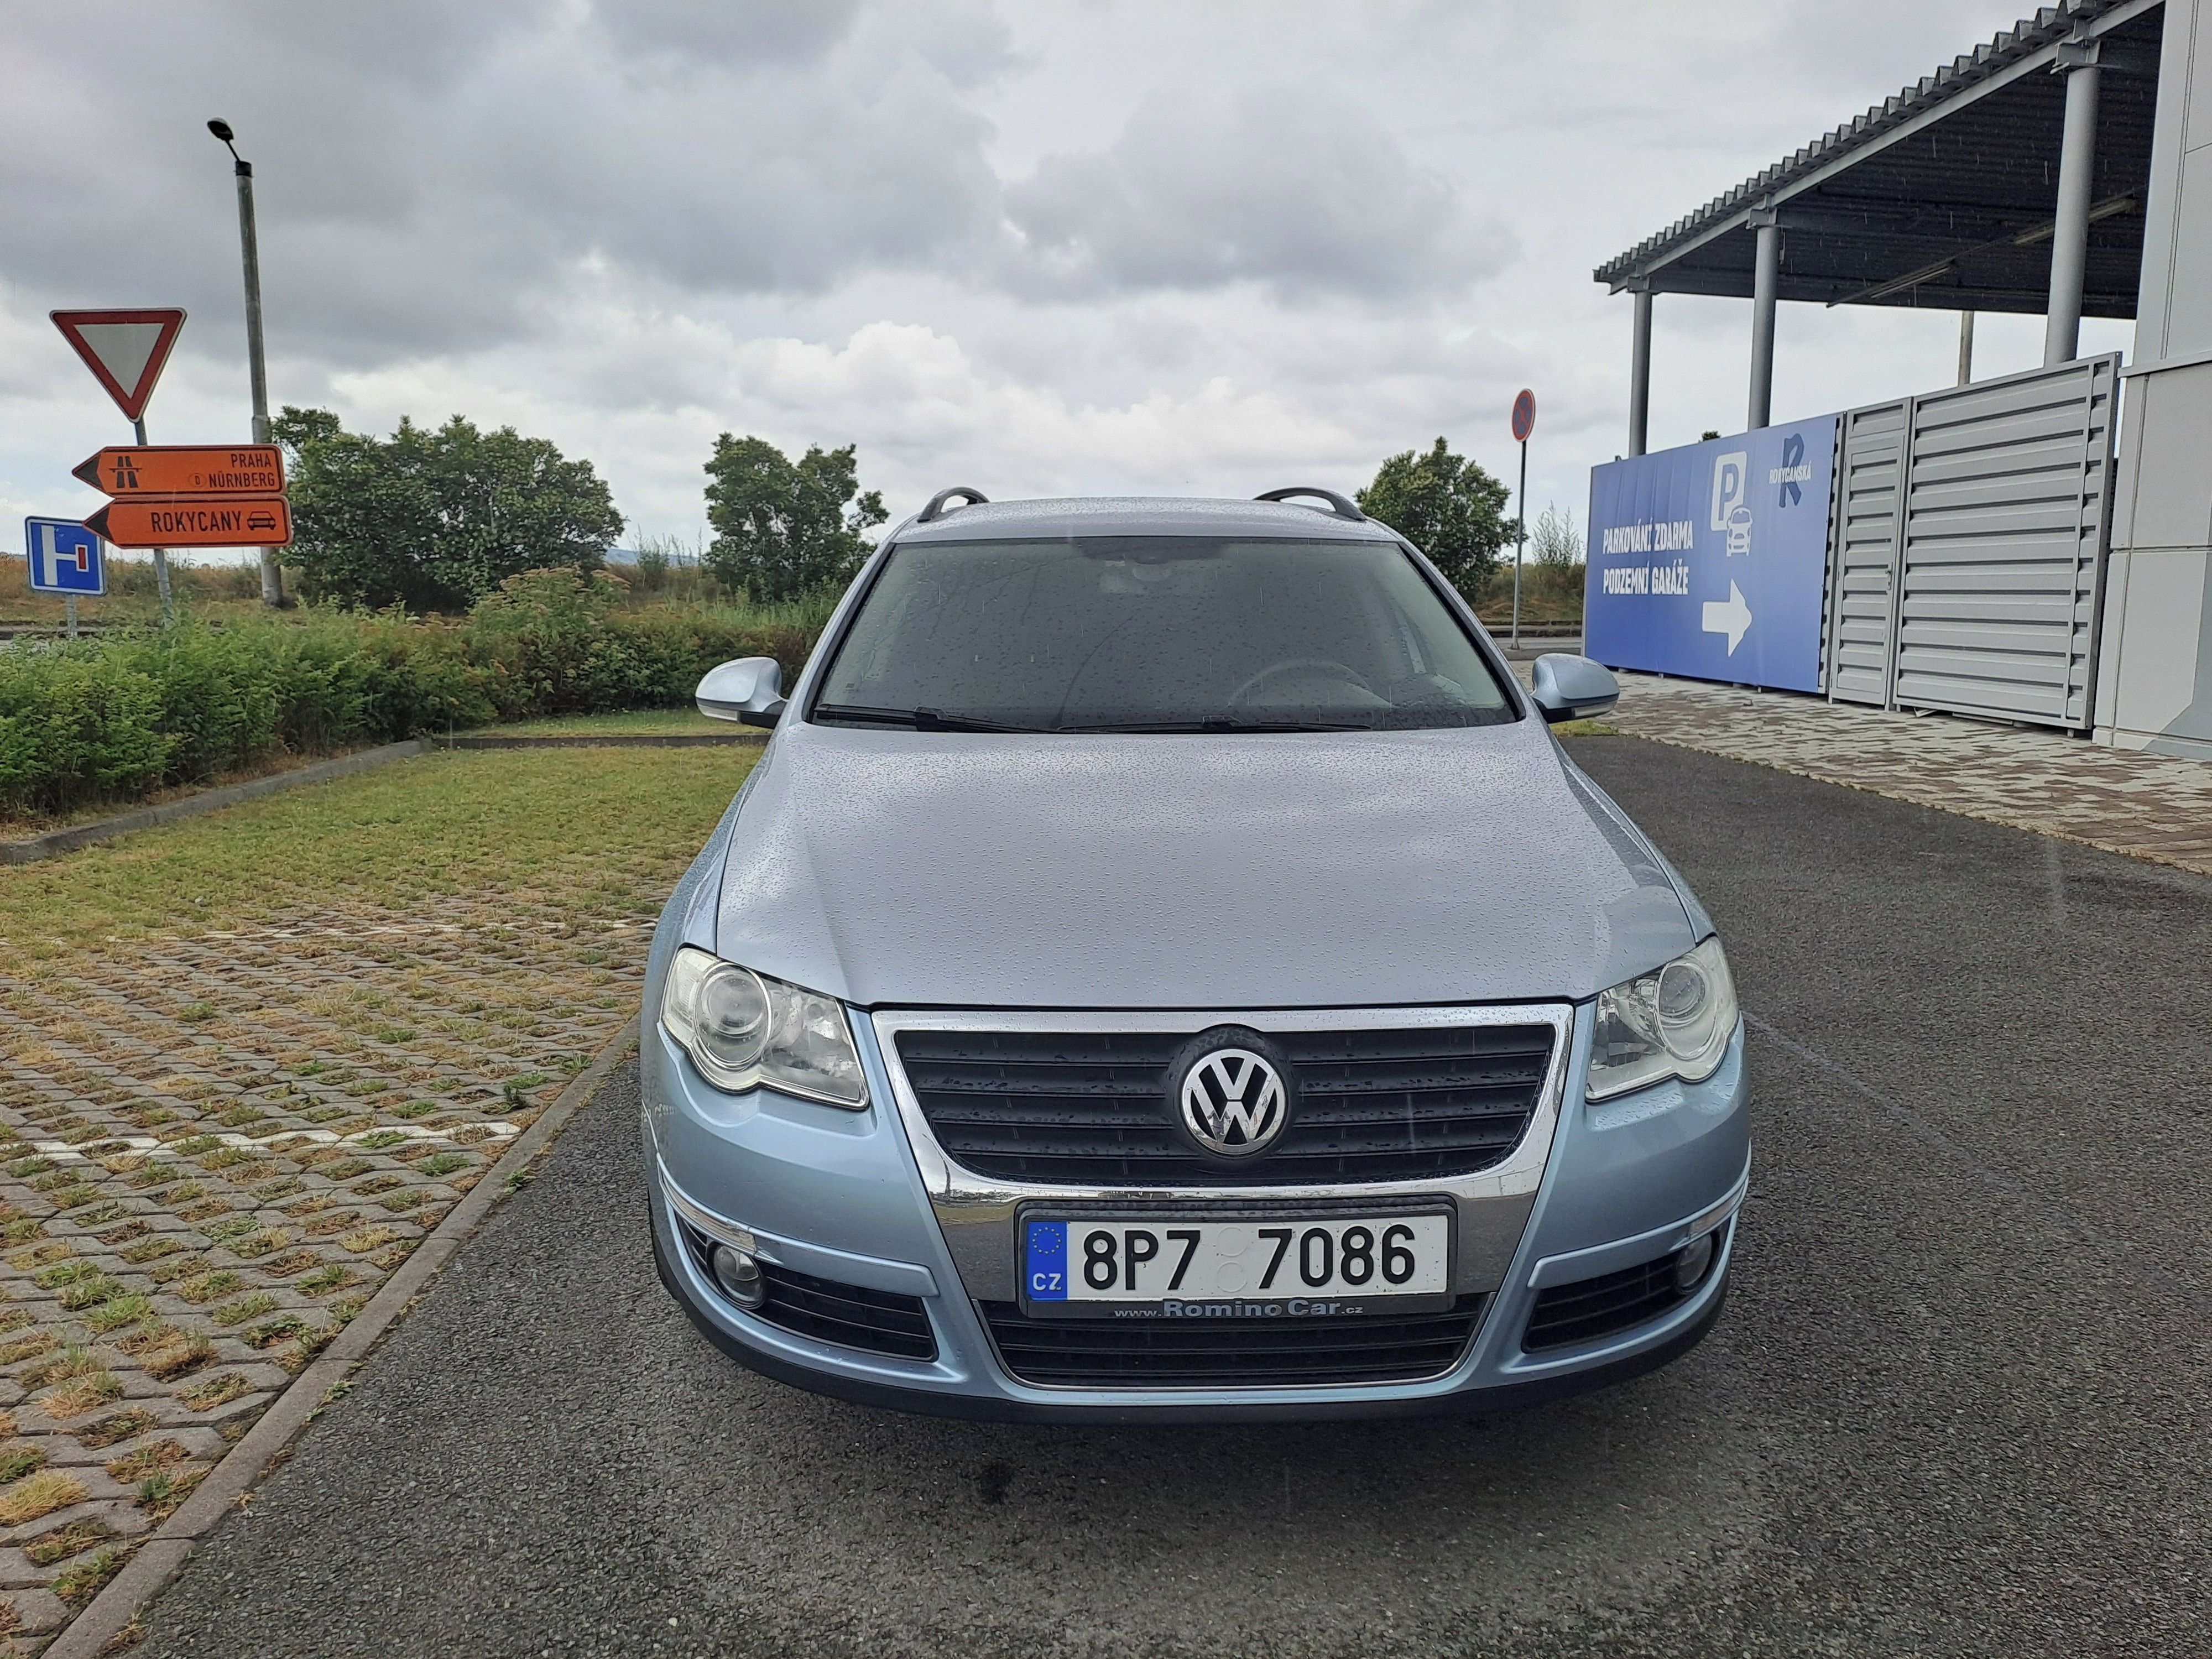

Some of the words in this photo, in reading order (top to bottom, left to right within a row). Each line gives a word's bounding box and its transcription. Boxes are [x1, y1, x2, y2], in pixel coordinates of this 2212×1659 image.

[231, 453, 272, 468] PRAHA
[209, 470, 275, 488] NÜRNBERG
[151, 510, 242, 533] ROKYCANY
[1603, 517, 1653, 554] PARKOVÁNÍ
[1654, 520, 1693, 551] ZDARMA
[1603, 560, 1650, 594] PODZEMNÍ
[1651, 558, 1689, 595] GARÁŽE
[1083, 1229, 1202, 1291] 8P7
[1258, 1223, 1416, 1290] 7086
[1032, 1272, 1062, 1291] CZ
